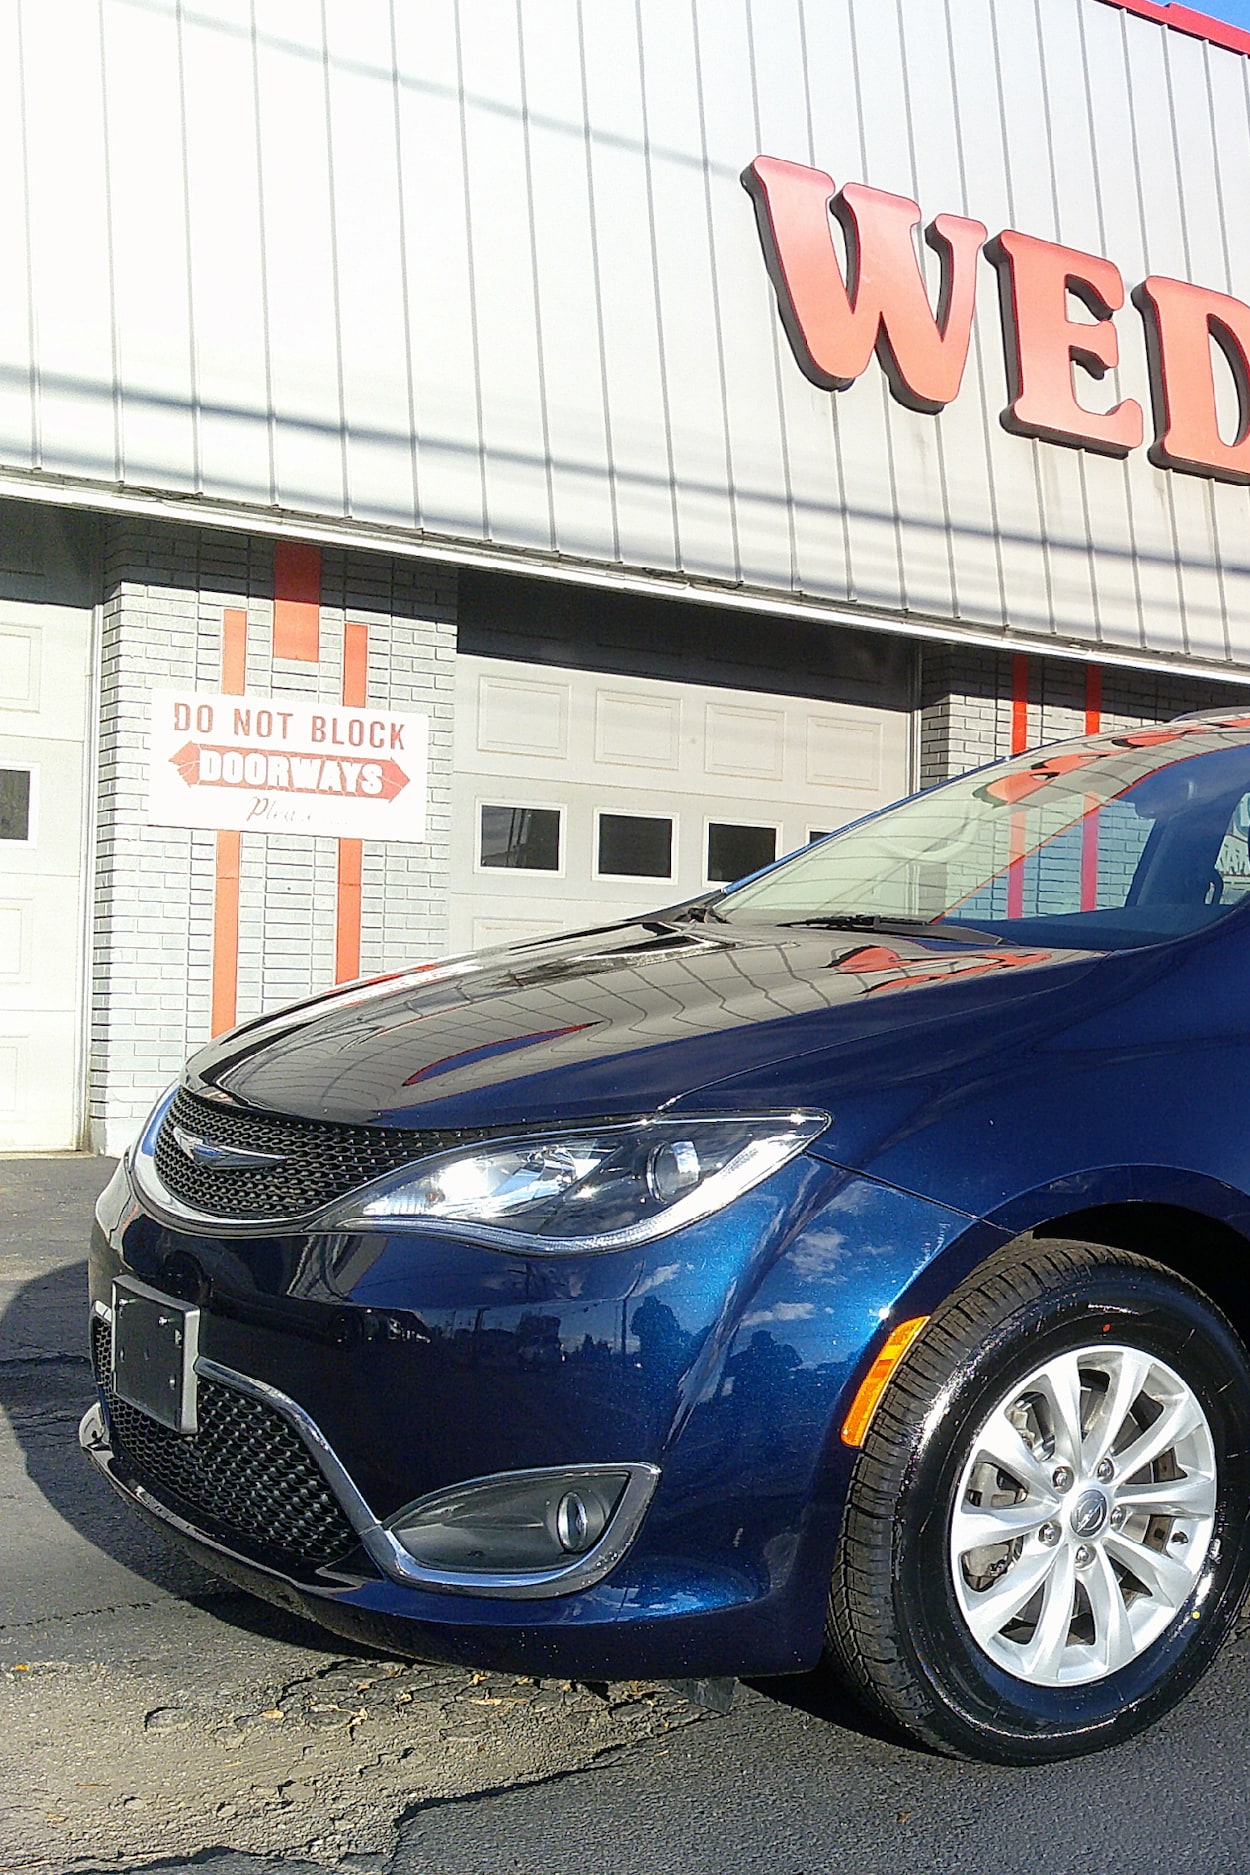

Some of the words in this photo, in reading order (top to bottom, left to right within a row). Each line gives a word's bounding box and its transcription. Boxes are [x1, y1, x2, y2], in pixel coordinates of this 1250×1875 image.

[173, 702, 214, 734] DO
[233, 708, 294, 740] NOT
[311, 715, 405, 750] BLOCK
[199, 750, 384, 795] DOORWAYS
